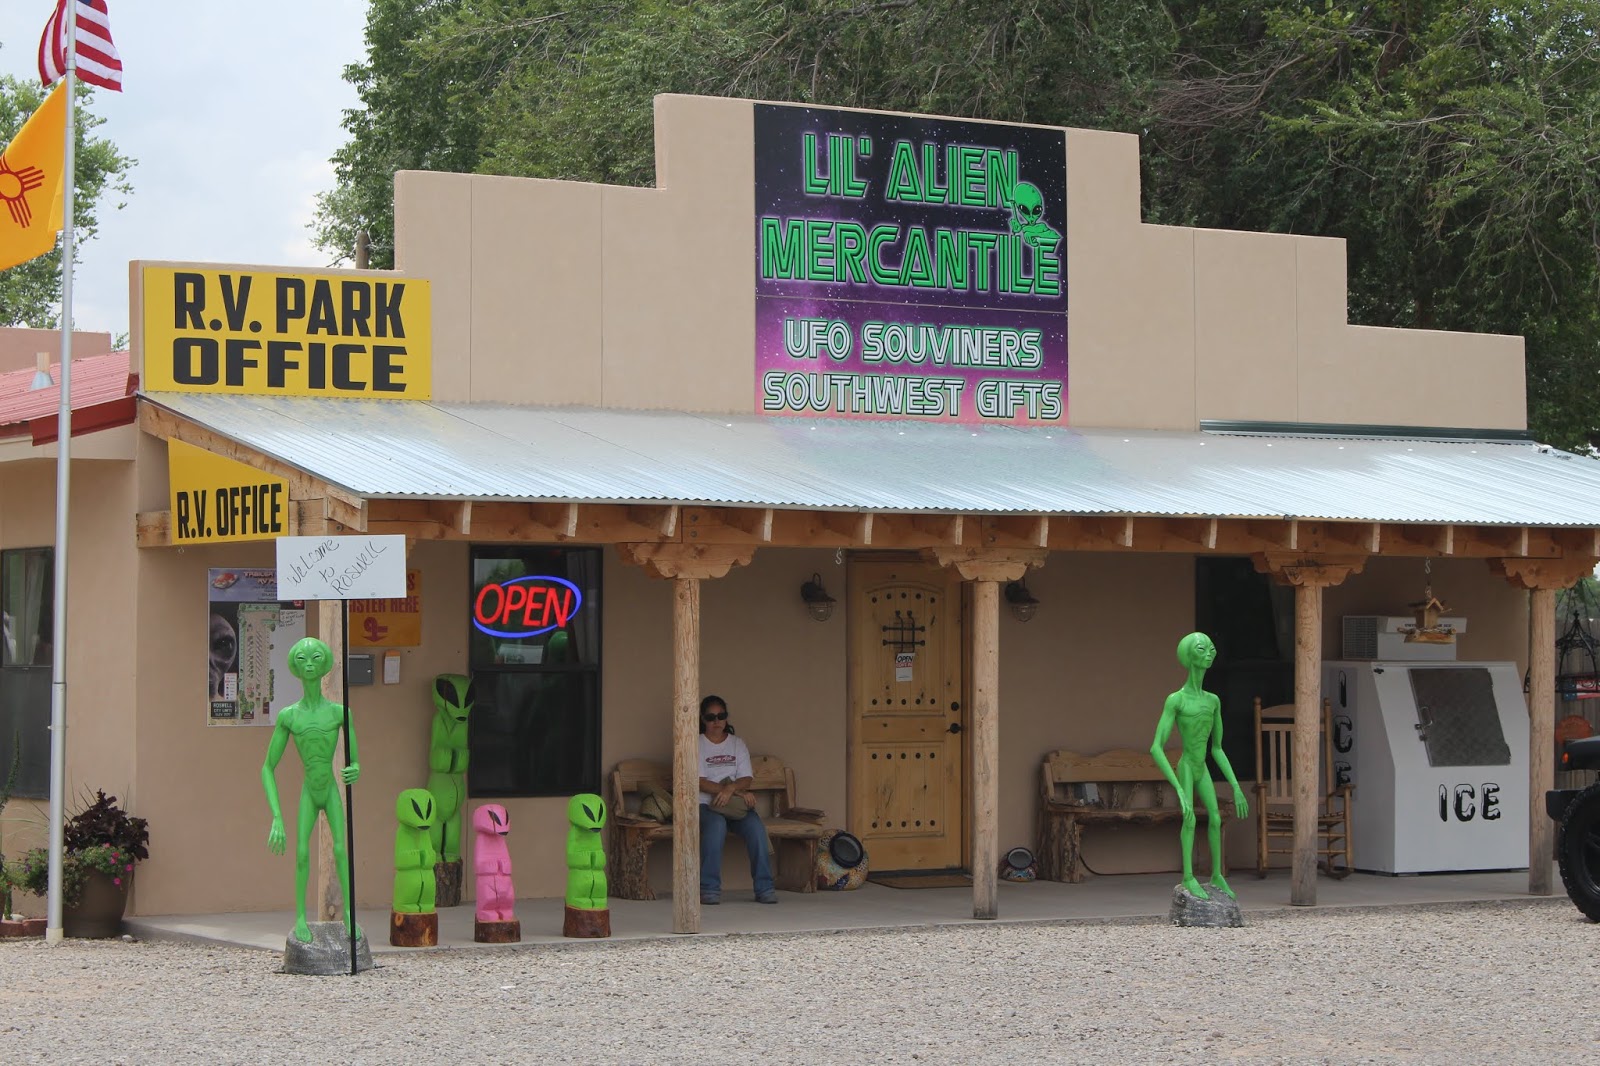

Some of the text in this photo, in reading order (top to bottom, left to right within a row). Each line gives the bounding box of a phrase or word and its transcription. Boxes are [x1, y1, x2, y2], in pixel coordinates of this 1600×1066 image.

[804, 133, 1017, 208] LIL' ALIEN
[762, 217, 1060, 296] MERCANTILE
[174, 272, 406, 338] R.V. PARK
[173, 337, 407, 392] OFFICE
[786, 319, 1041, 368] UFO SOUVINERS
[764, 372, 1062, 419] SOUTHWEST GIFTS
[177, 483, 282, 539] R.V. OFFICE
[318, 566, 335, 583] to
[390, 595, 420, 613] HERE
[475, 583, 572, 628] OPEN
[1439, 783, 1501, 822] ICE
